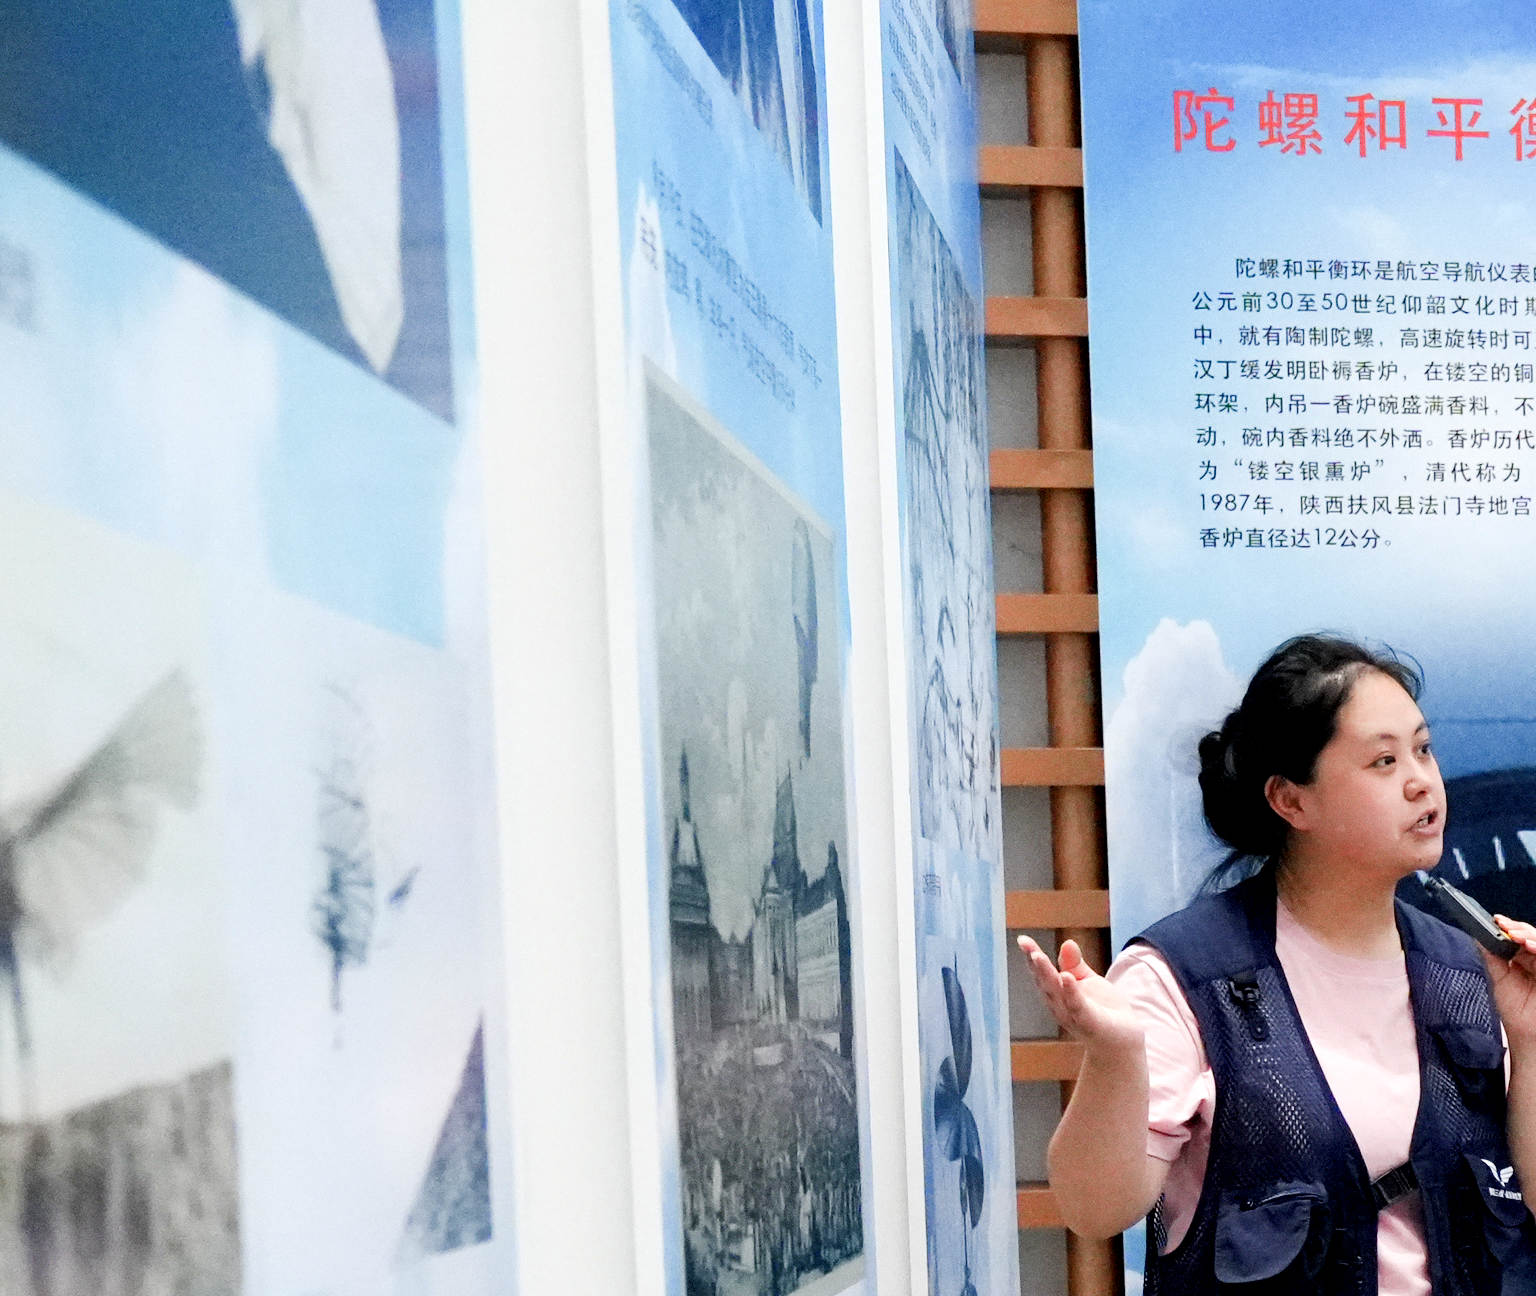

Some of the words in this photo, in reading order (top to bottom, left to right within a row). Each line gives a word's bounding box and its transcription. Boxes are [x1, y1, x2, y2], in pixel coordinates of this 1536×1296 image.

[1200, 527, 1392, 549] 香炉直径达12公分。
